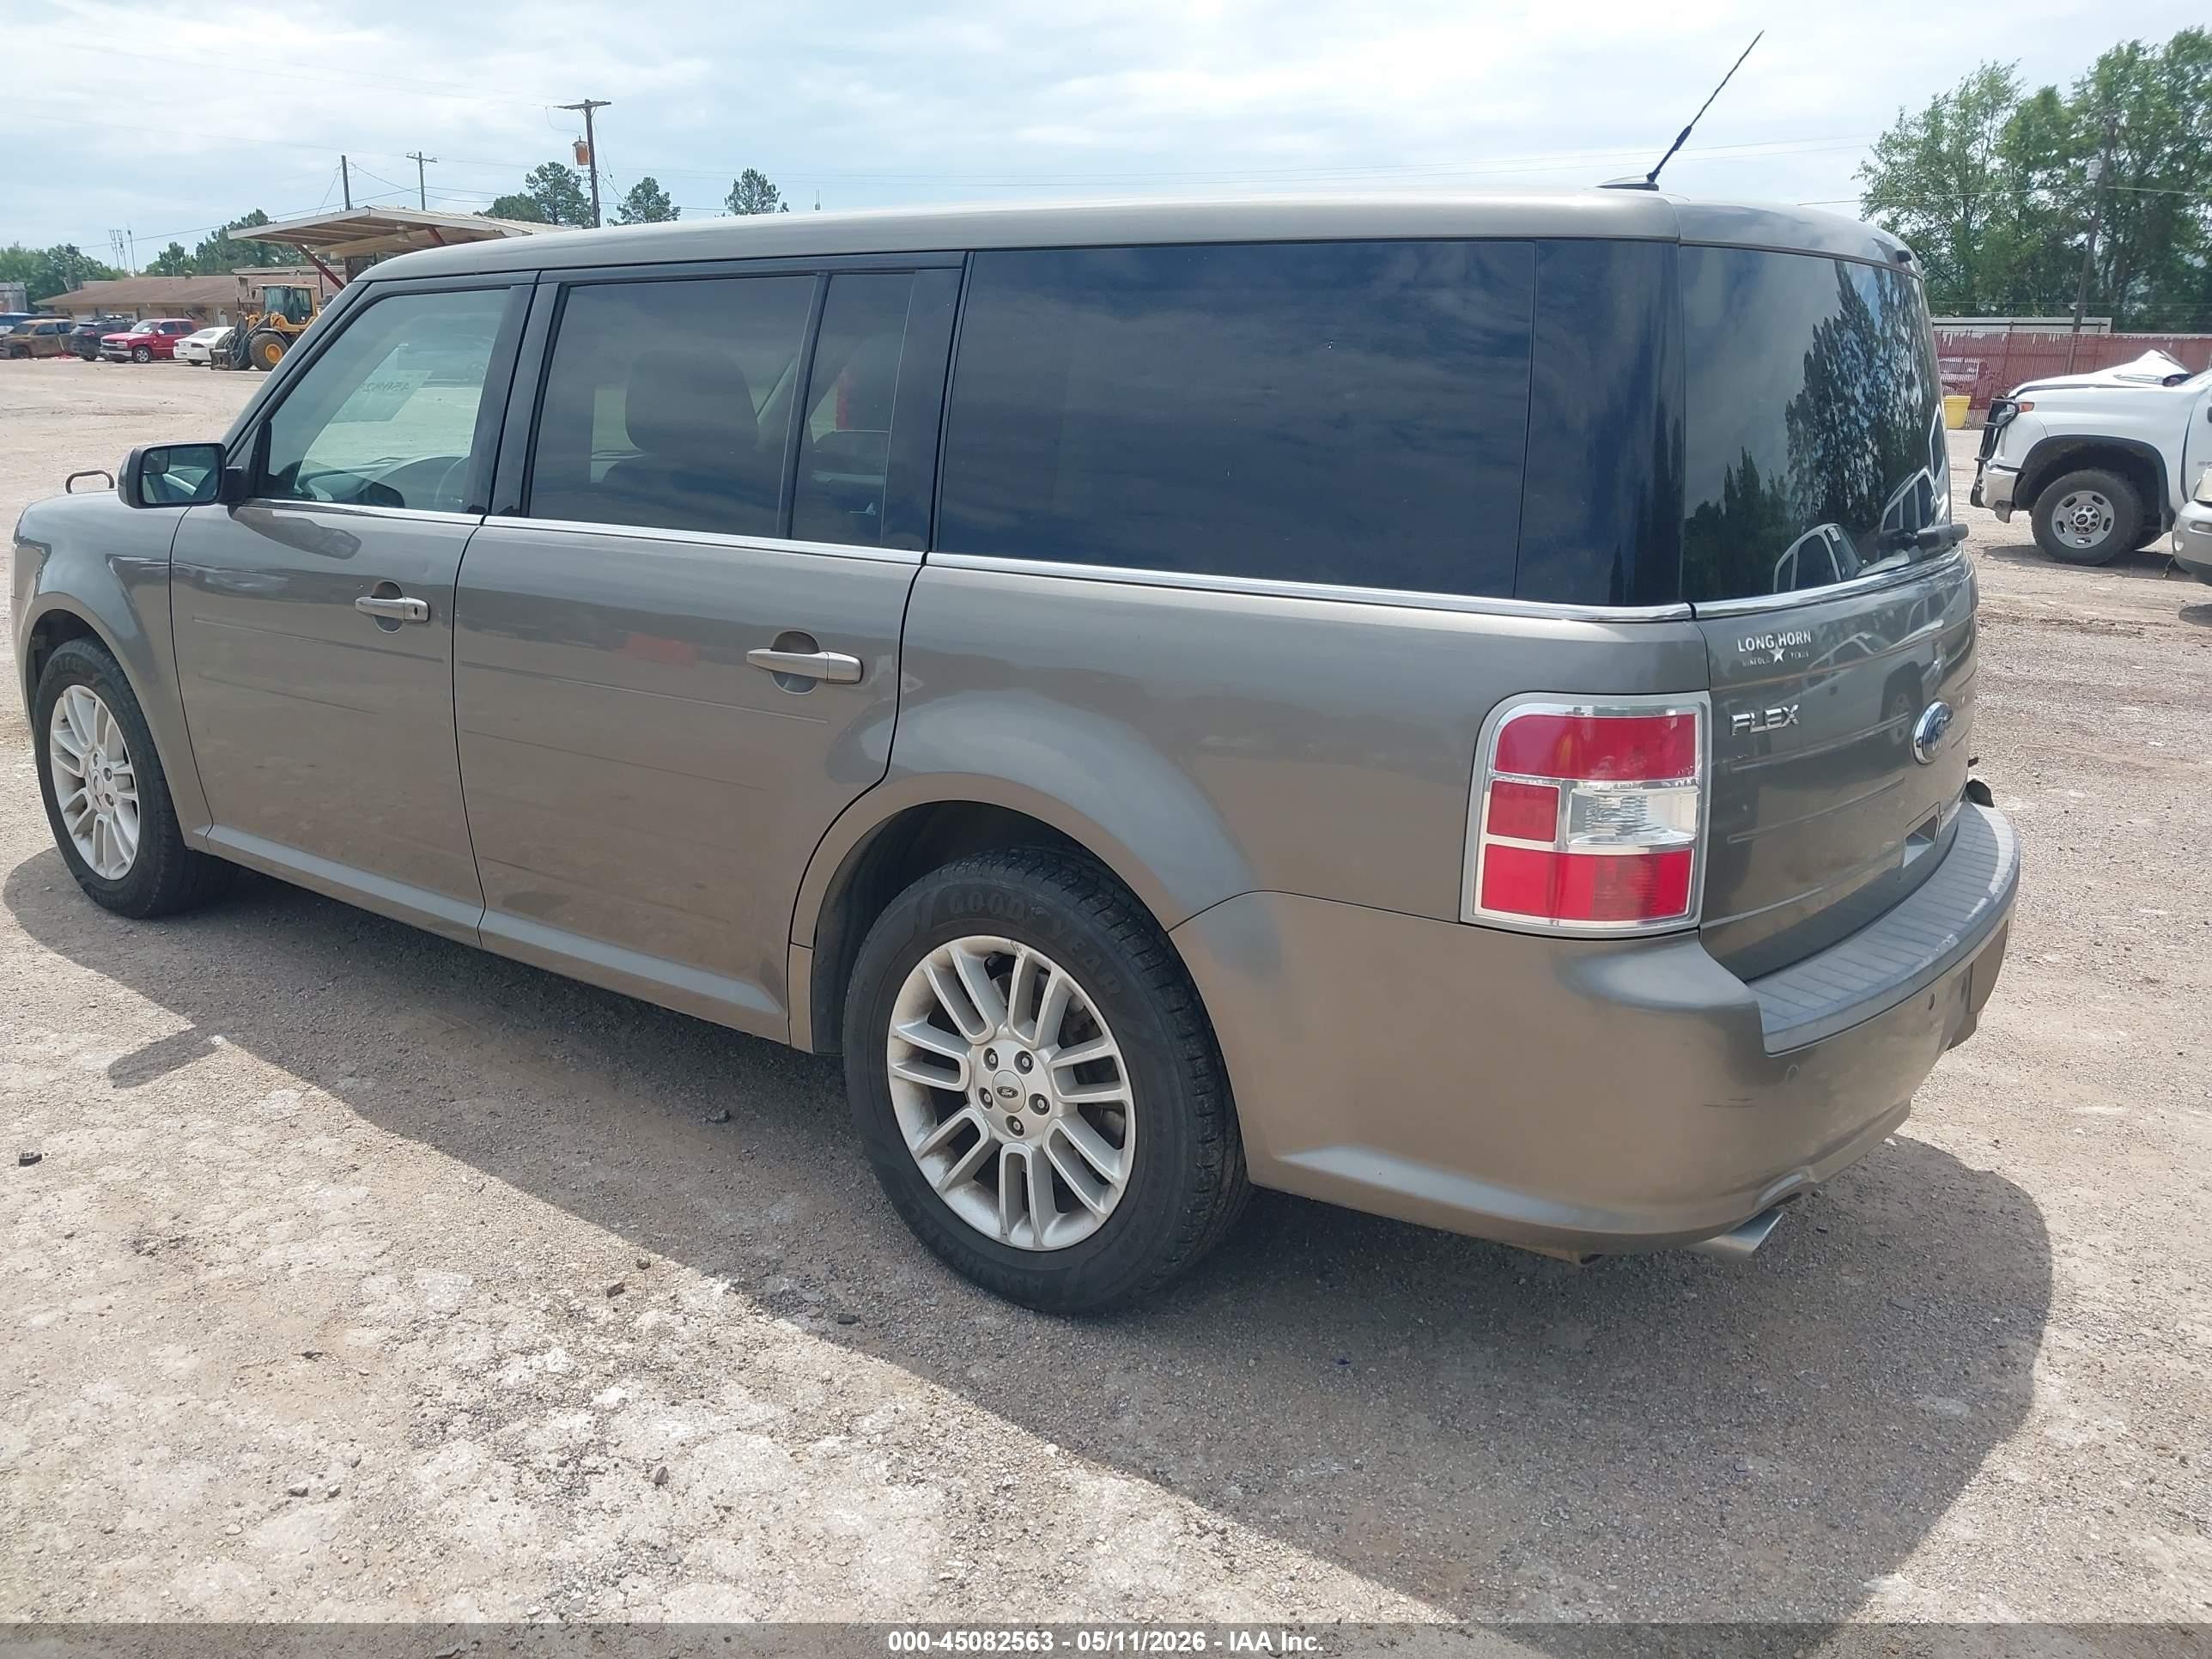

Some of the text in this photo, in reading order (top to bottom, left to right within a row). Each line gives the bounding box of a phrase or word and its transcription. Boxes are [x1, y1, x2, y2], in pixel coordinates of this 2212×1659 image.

[1737, 629, 1812, 653] LONG HORN
[1730, 704, 1800, 736] FLEX
